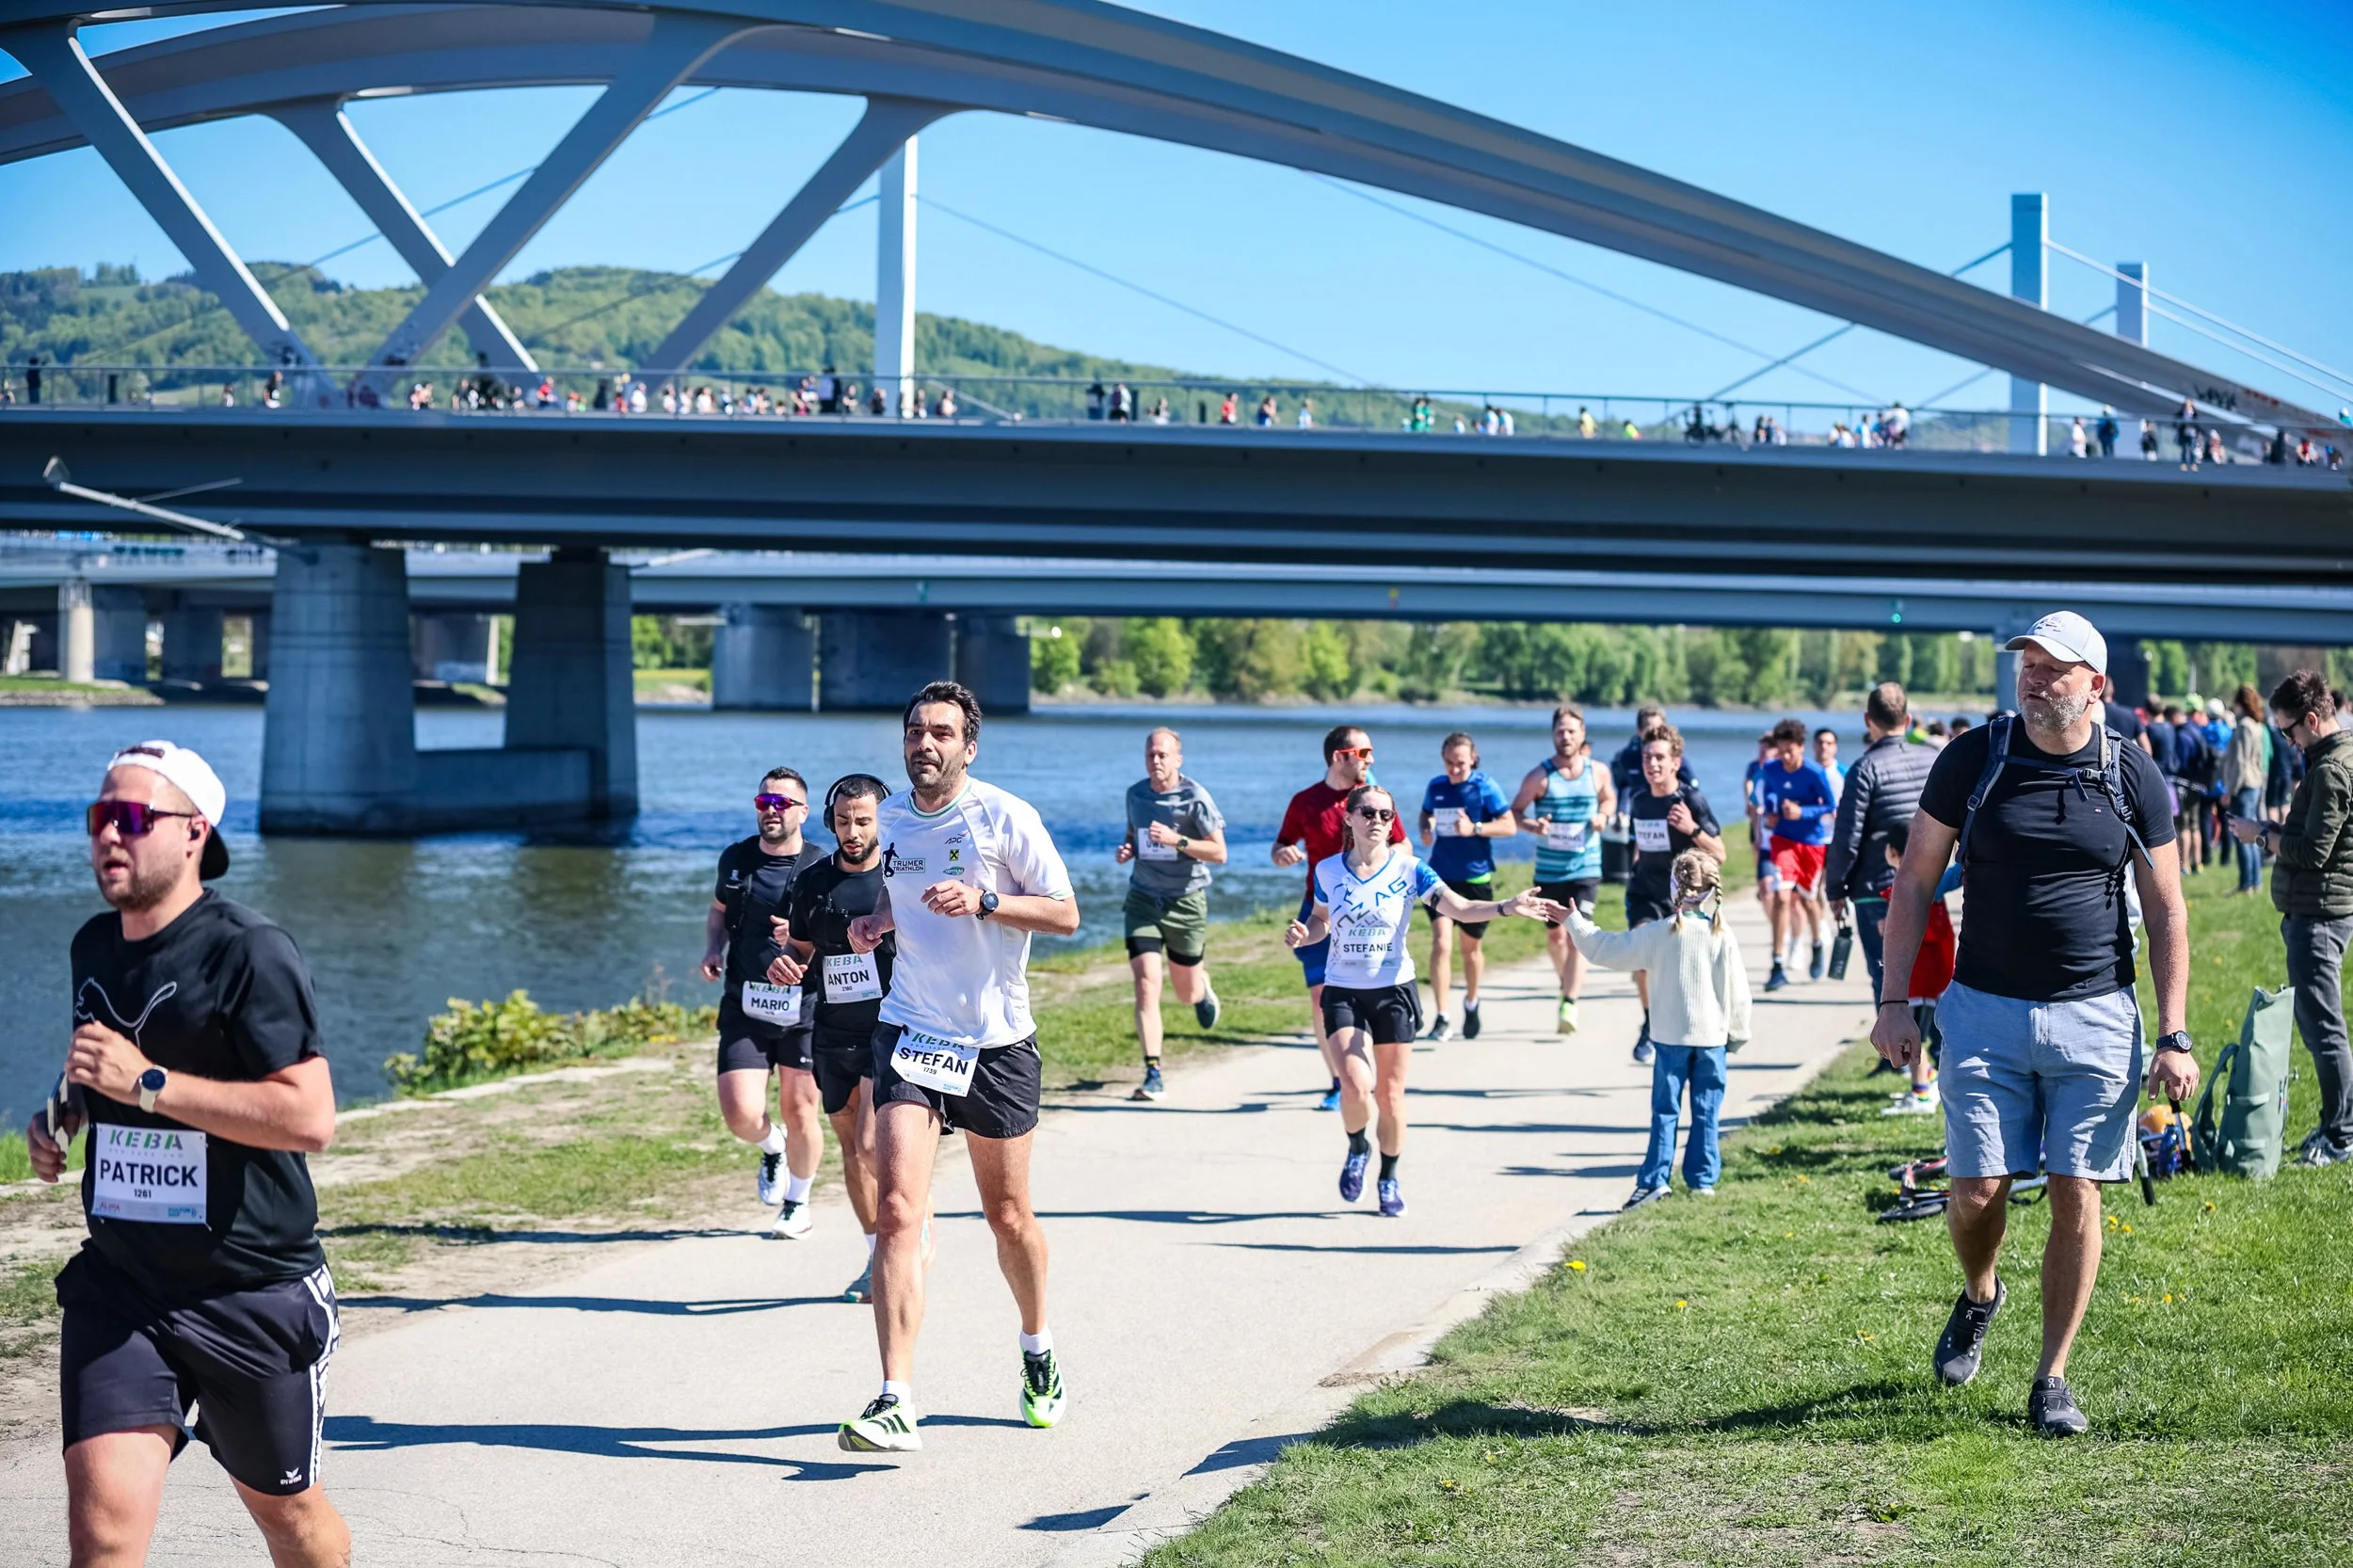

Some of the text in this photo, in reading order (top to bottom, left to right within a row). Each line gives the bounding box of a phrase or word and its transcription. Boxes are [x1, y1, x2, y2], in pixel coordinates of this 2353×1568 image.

[1348, 928, 1386, 937] KEBA
[1343, 942, 1393, 952] STEFANIE
[826, 955, 863, 968] KEBA
[828, 969, 870, 985] ANTON
[750, 998, 790, 1011] MARIO
[899, 1047, 968, 1075] STEFAN
[923, 1066, 937, 1075] 1739
[109, 1129, 184, 1150] KEBA
[100, 1159, 199, 1188] PATRICK
[134, 1189, 152, 1199] 1261
